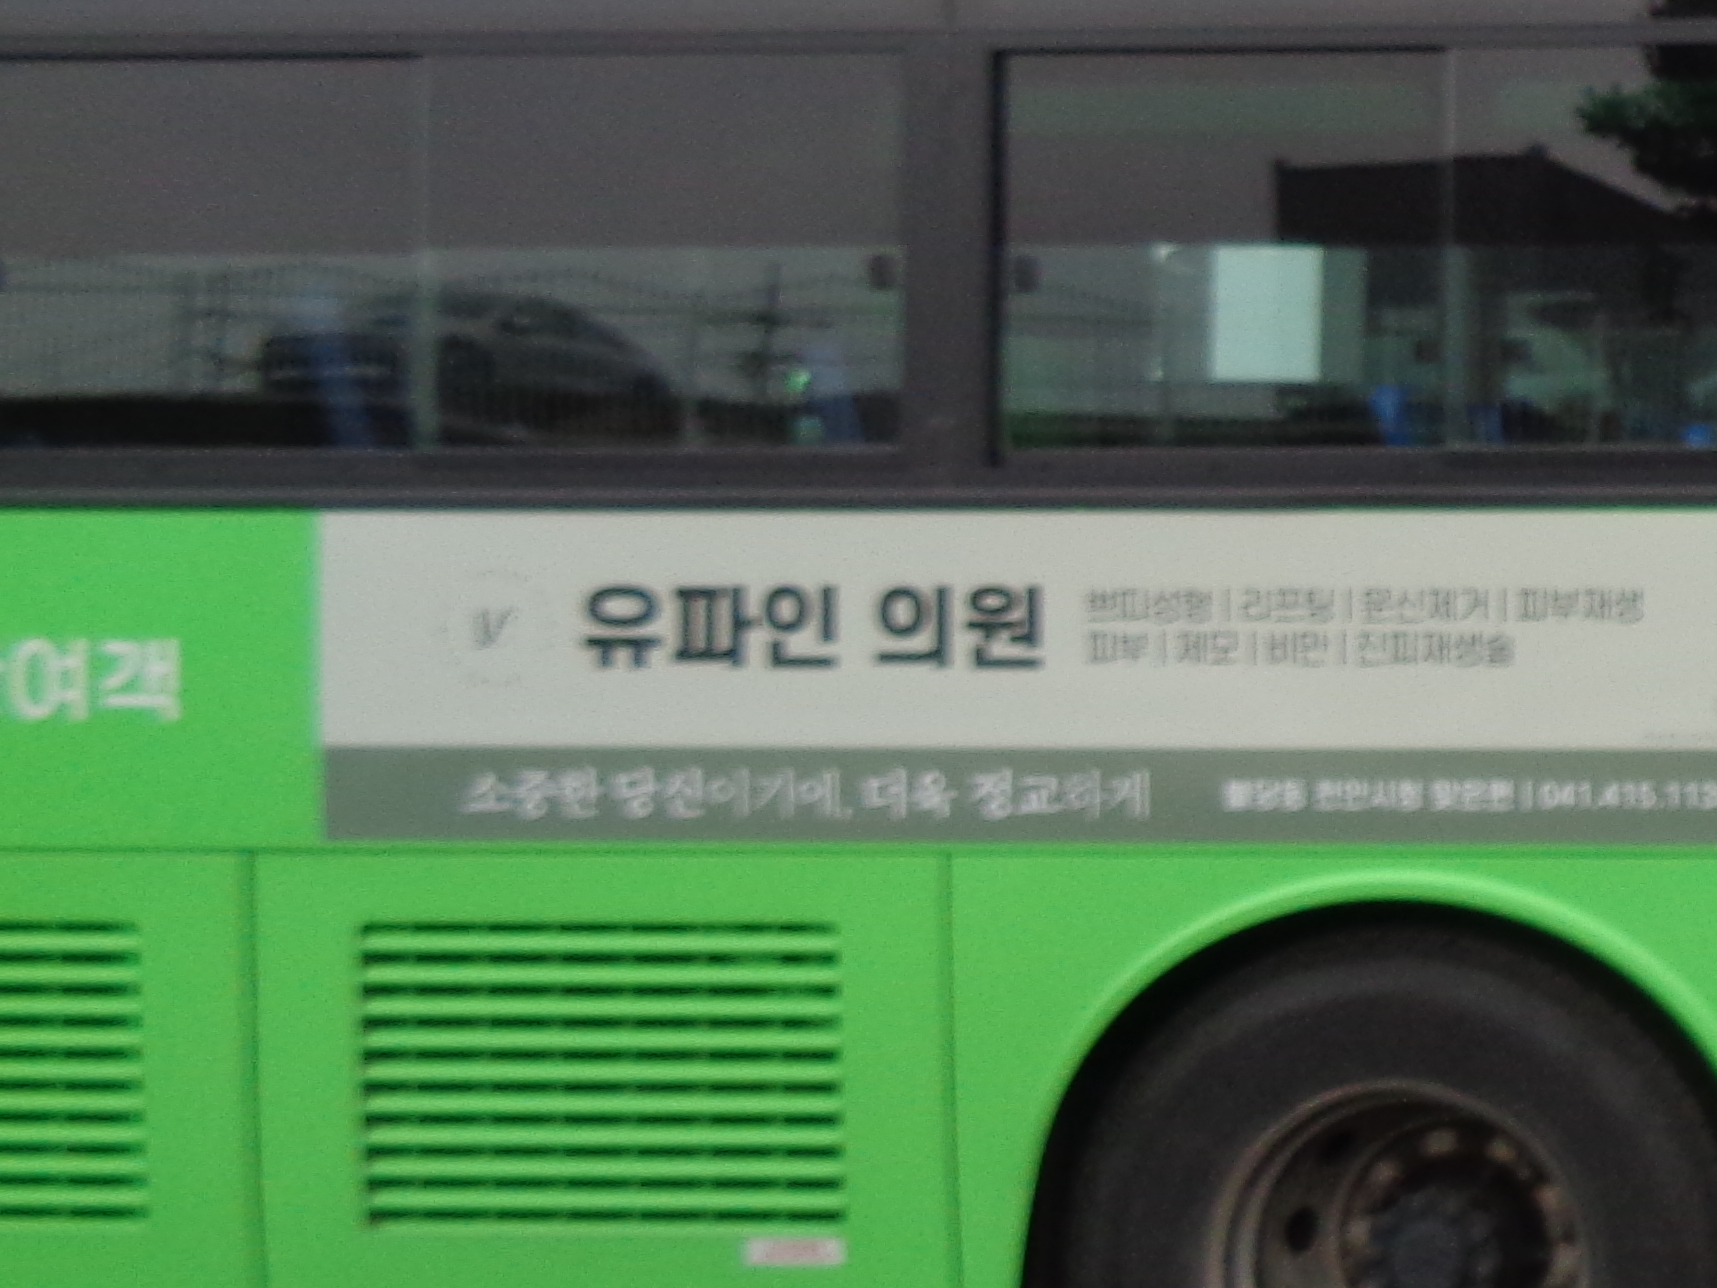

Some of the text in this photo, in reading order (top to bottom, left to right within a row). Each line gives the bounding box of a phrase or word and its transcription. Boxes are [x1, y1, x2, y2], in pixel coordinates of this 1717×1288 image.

[582, 583, 840, 670] 유파인
[873, 583, 1046, 670] 의원
[0, 637, 182, 722] 여객
